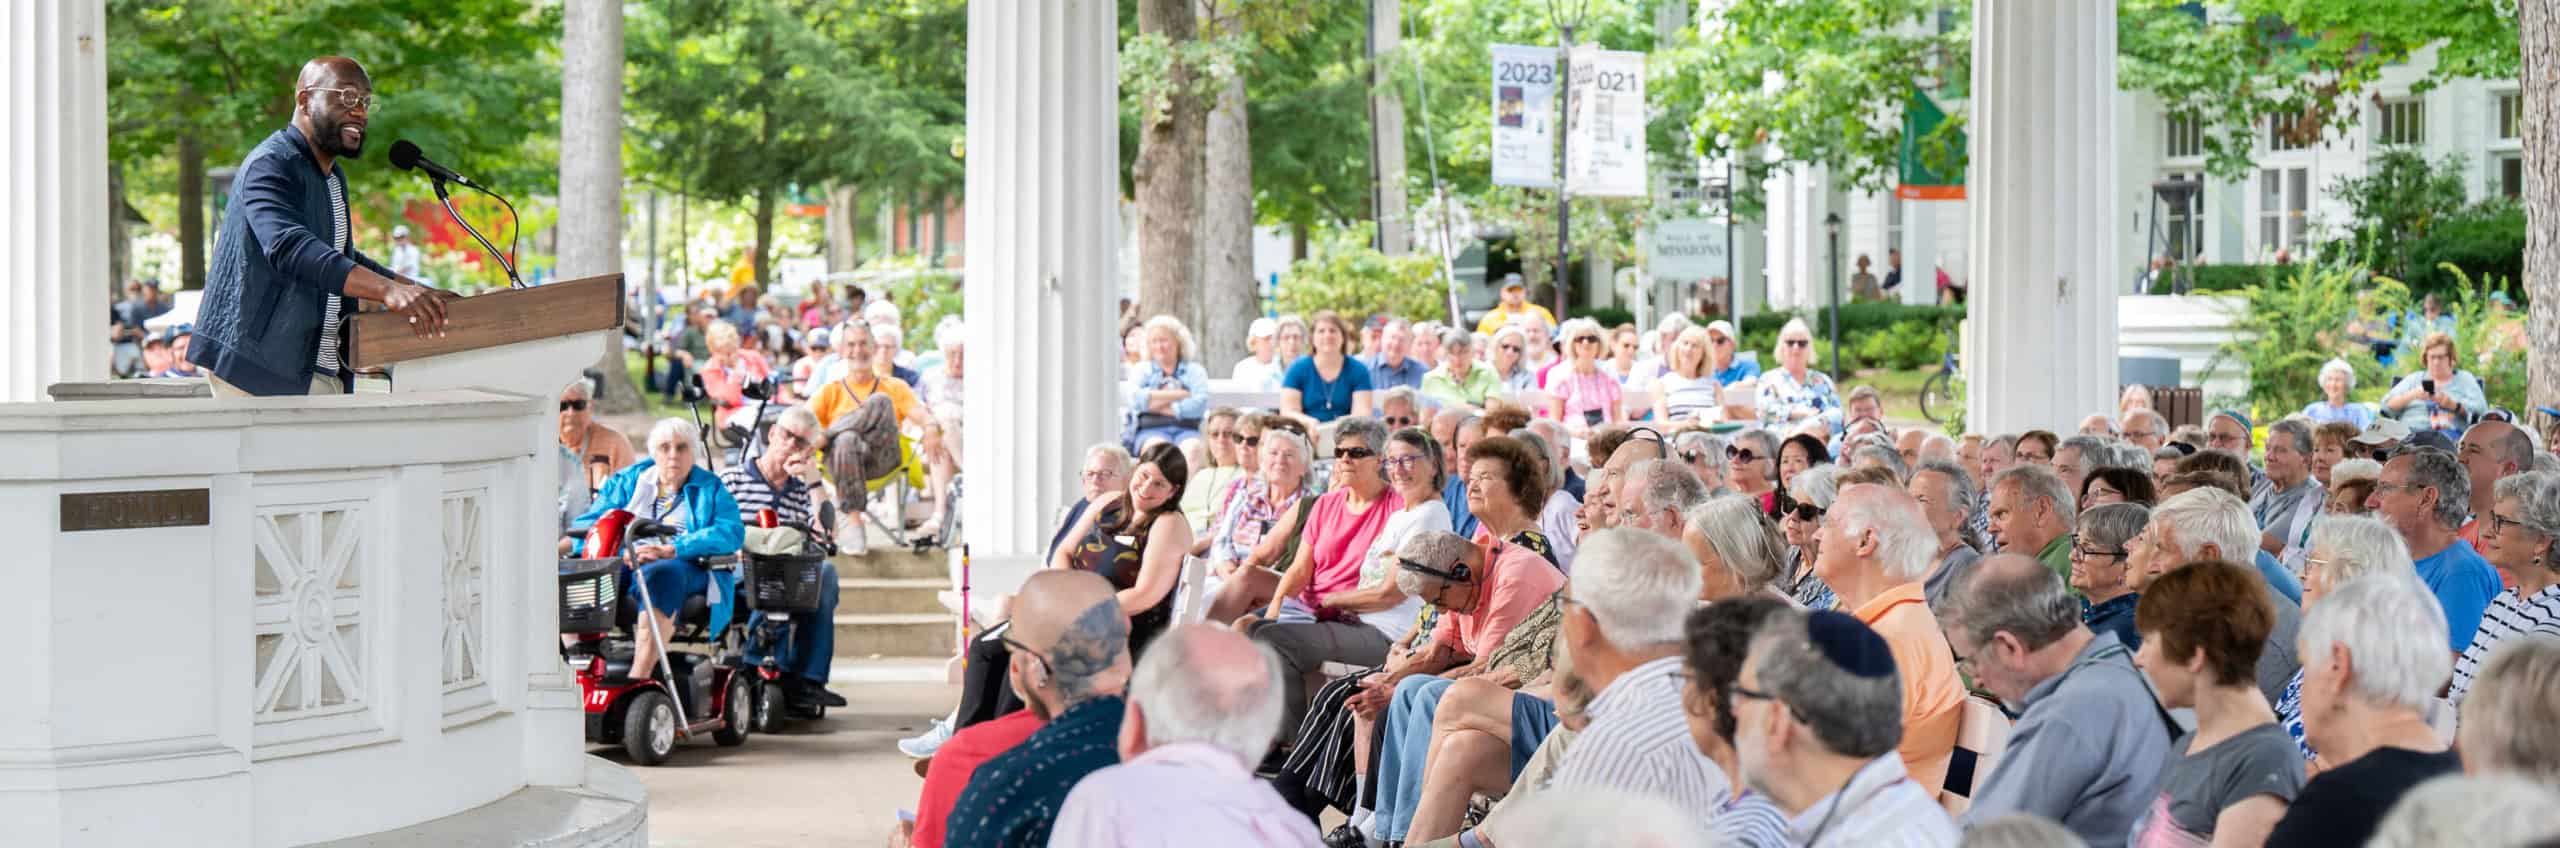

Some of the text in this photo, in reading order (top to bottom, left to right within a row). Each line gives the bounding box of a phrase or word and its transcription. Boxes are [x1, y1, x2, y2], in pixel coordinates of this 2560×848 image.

[1499, 62, 1553, 84] 2023
[1597, 72, 1637, 92] 021
[591, 690, 609, 705] 17
